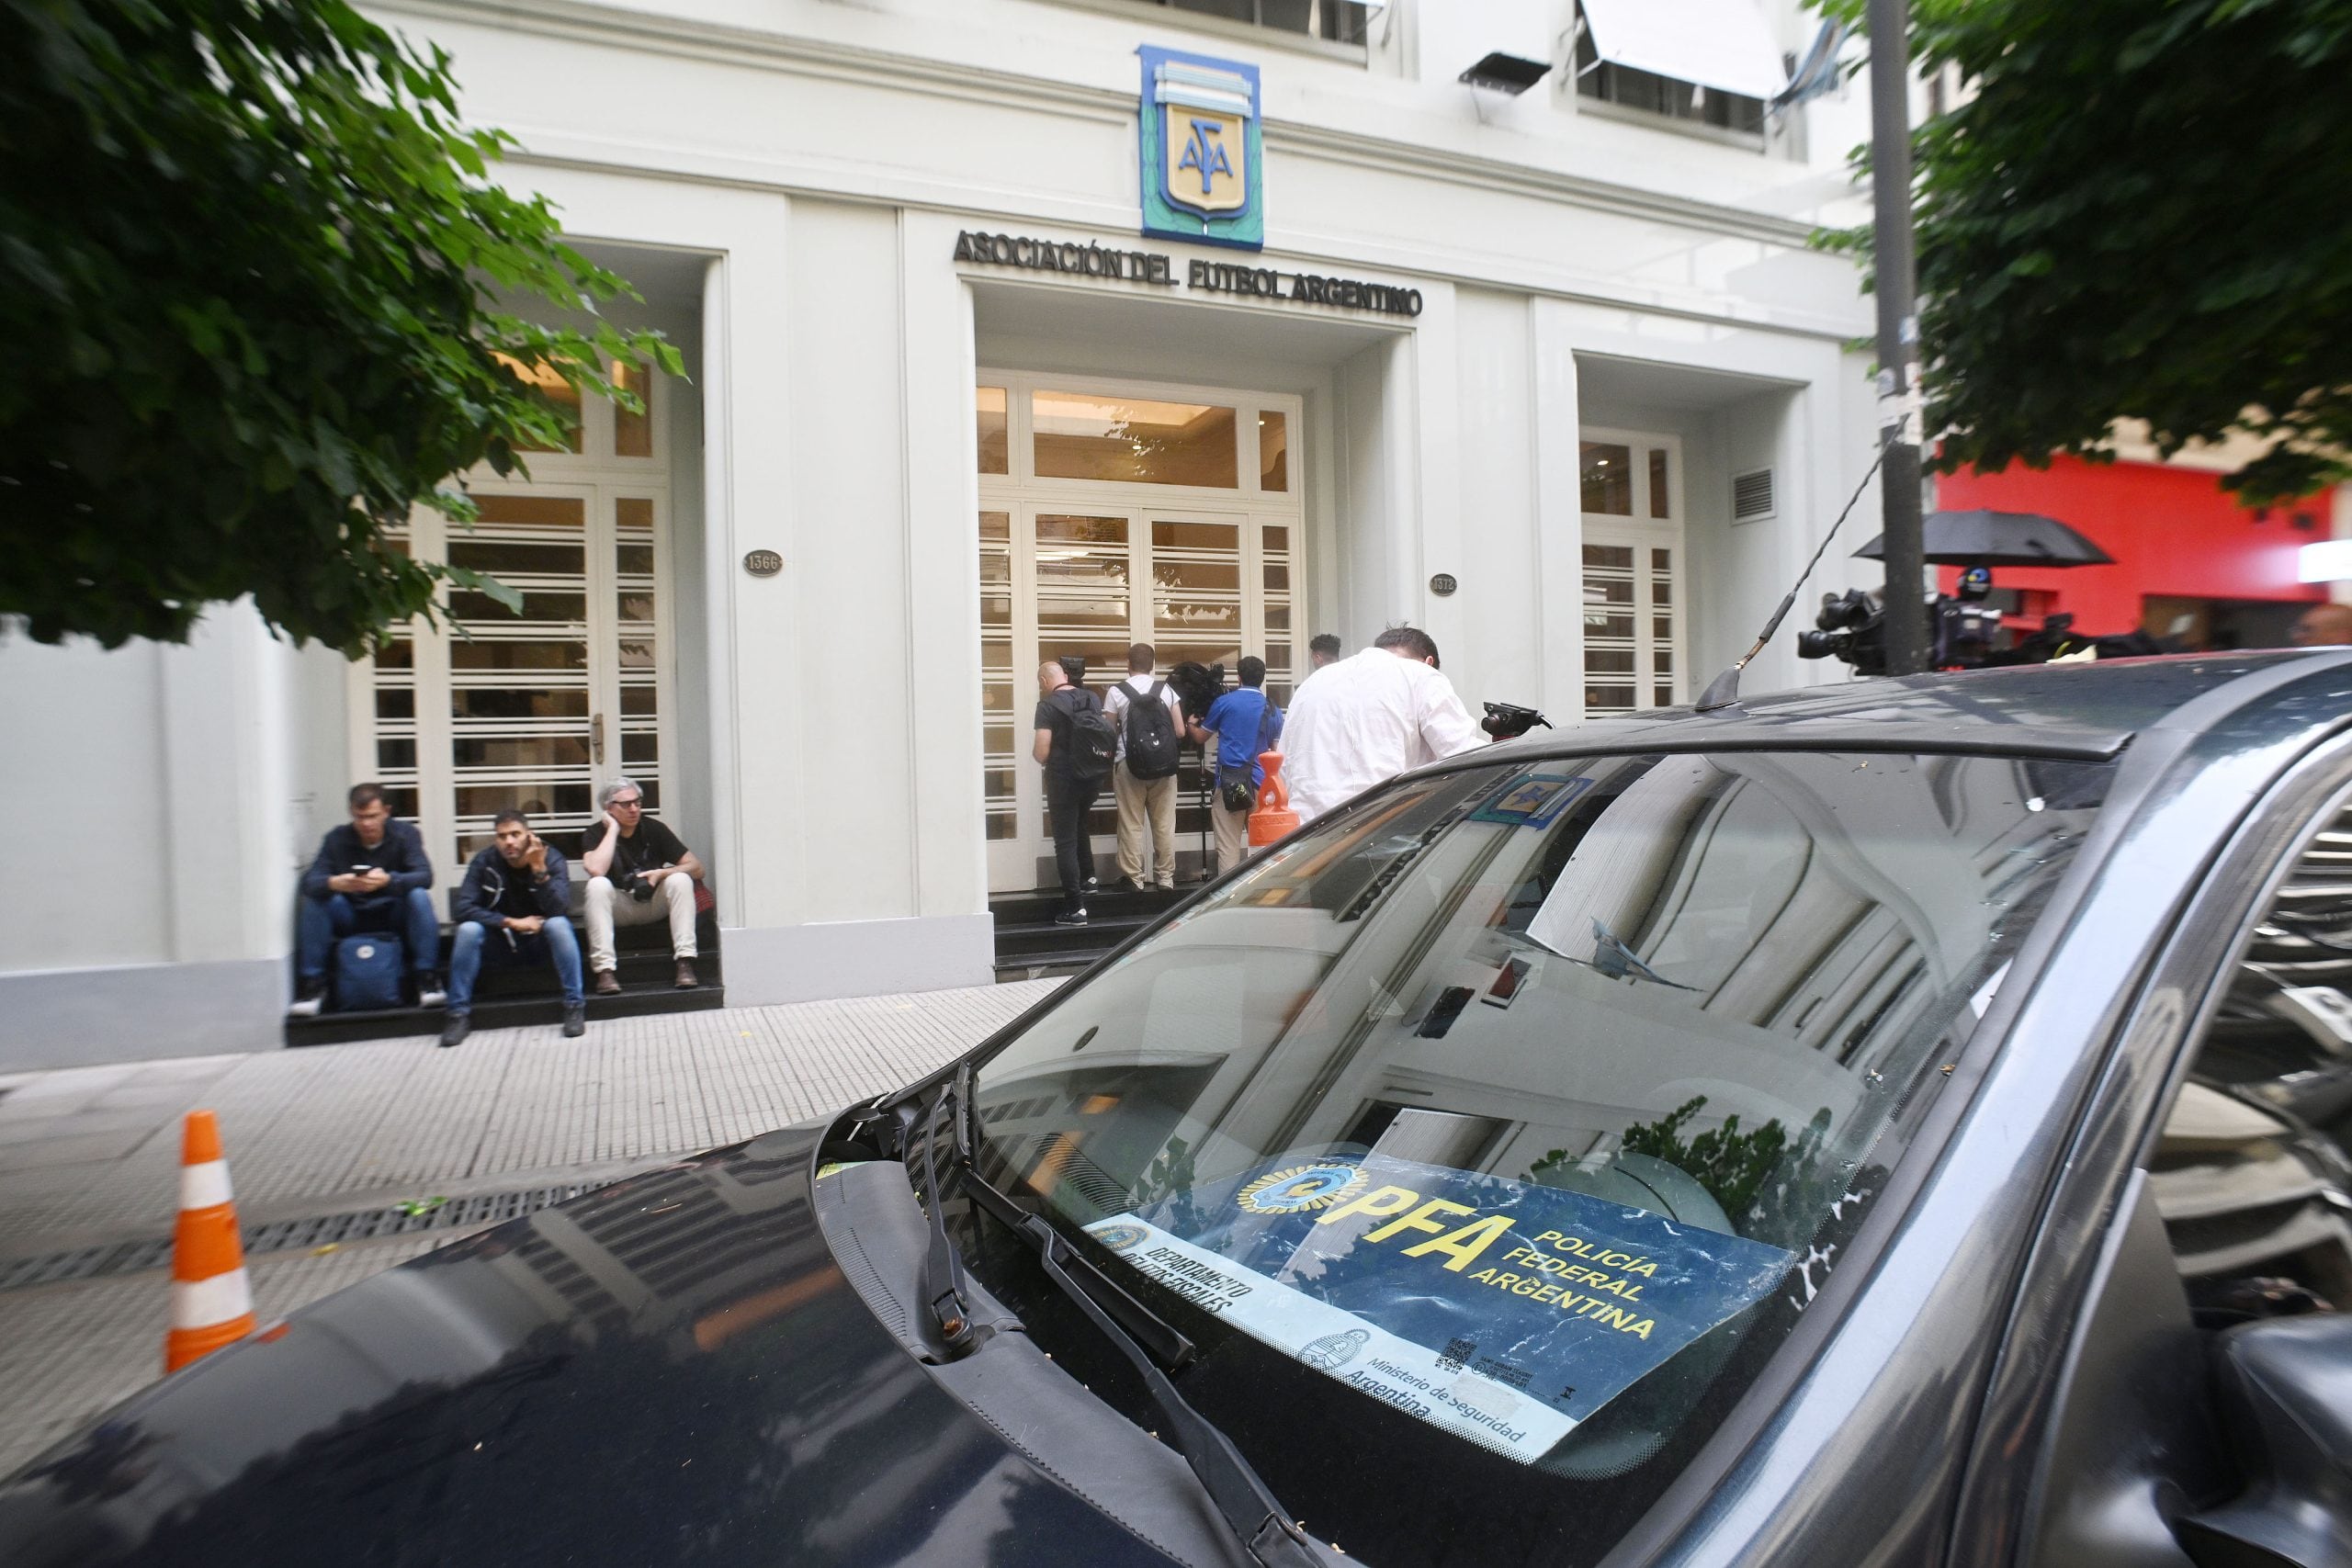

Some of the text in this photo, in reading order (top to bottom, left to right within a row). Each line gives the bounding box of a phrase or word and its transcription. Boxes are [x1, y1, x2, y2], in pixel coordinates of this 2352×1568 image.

[954, 230, 1423, 317] ASOCIACIÓN DEL FUTBOL ARGENTINO
[749, 555, 778, 570] 1366
[1314, 1185, 1517, 1272] PFA
[1532, 1230, 1658, 1278] POLICÍA
[1145, 1247, 1254, 1298] DEPARTAMENTO
[1501, 1247, 1645, 1302] FEDERAL
[1467, 1268, 1655, 1340] ARGENTINA
[1348, 1370, 1430, 1417] Argentina
[1367, 1357, 1526, 1443] Ministerio de Seguridad
